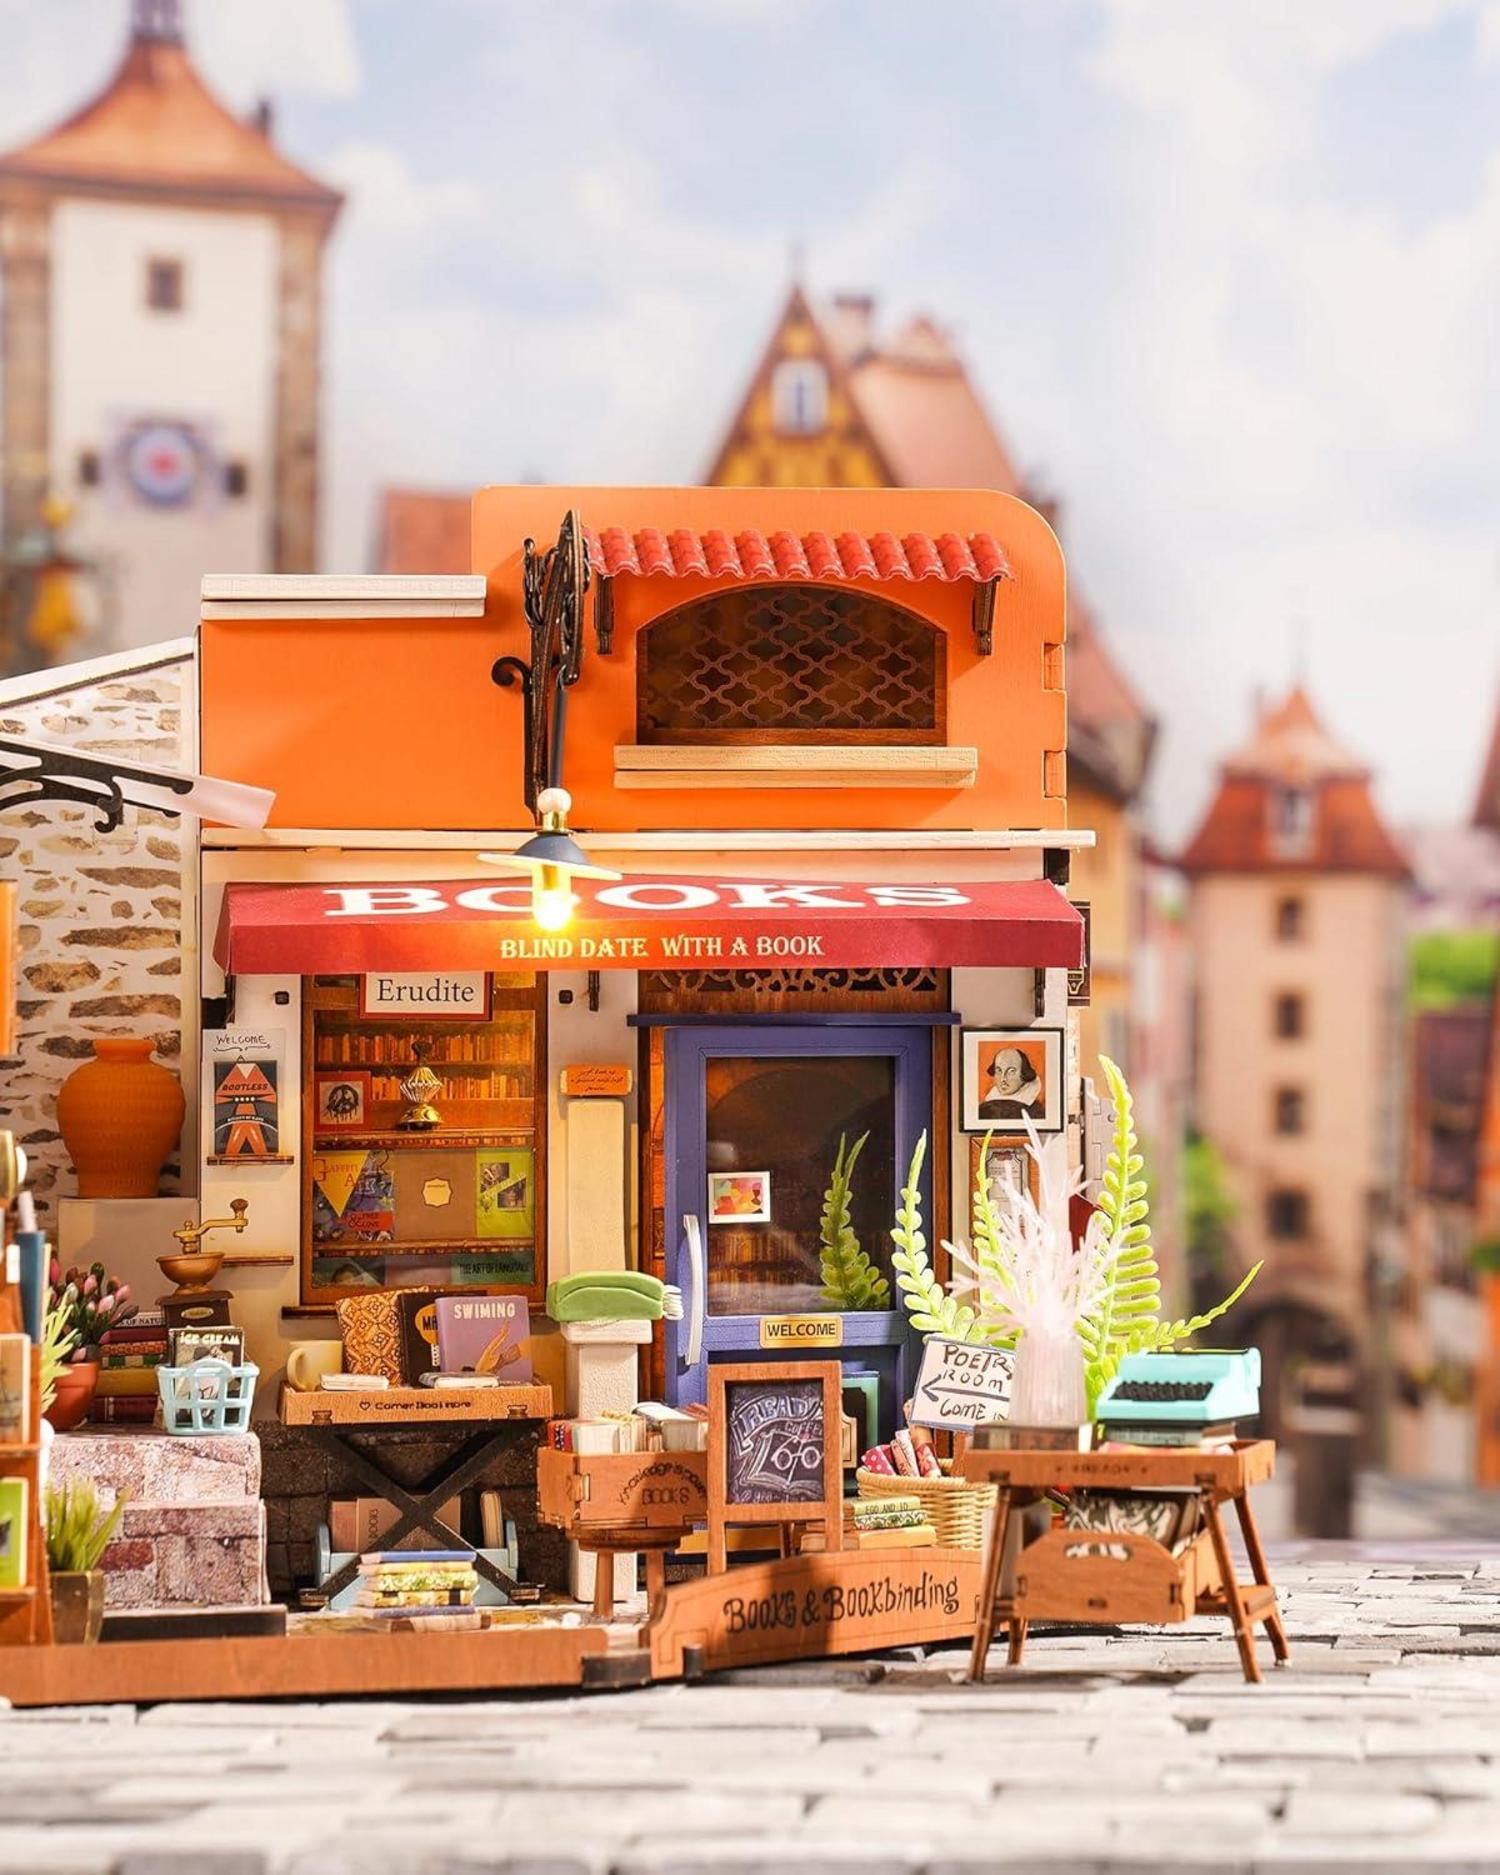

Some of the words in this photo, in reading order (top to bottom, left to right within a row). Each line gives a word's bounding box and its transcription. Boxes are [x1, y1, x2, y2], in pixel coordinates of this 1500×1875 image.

[500, 939, 573, 959] BLIND
[580, 937, 649, 958] DATE
[661, 934, 722, 957] WITH
[729, 937, 749, 957] A
[756, 936, 825, 956] BOOK
[376, 978, 475, 1002] Erudite
[201, 1332, 241, 1345] CREAM
[767, 1323, 836, 1337] WELCOME
[939, 1399, 987, 1421] COME
[882, 1502, 896, 1513] AND
[801, 1588, 822, 1627] &
